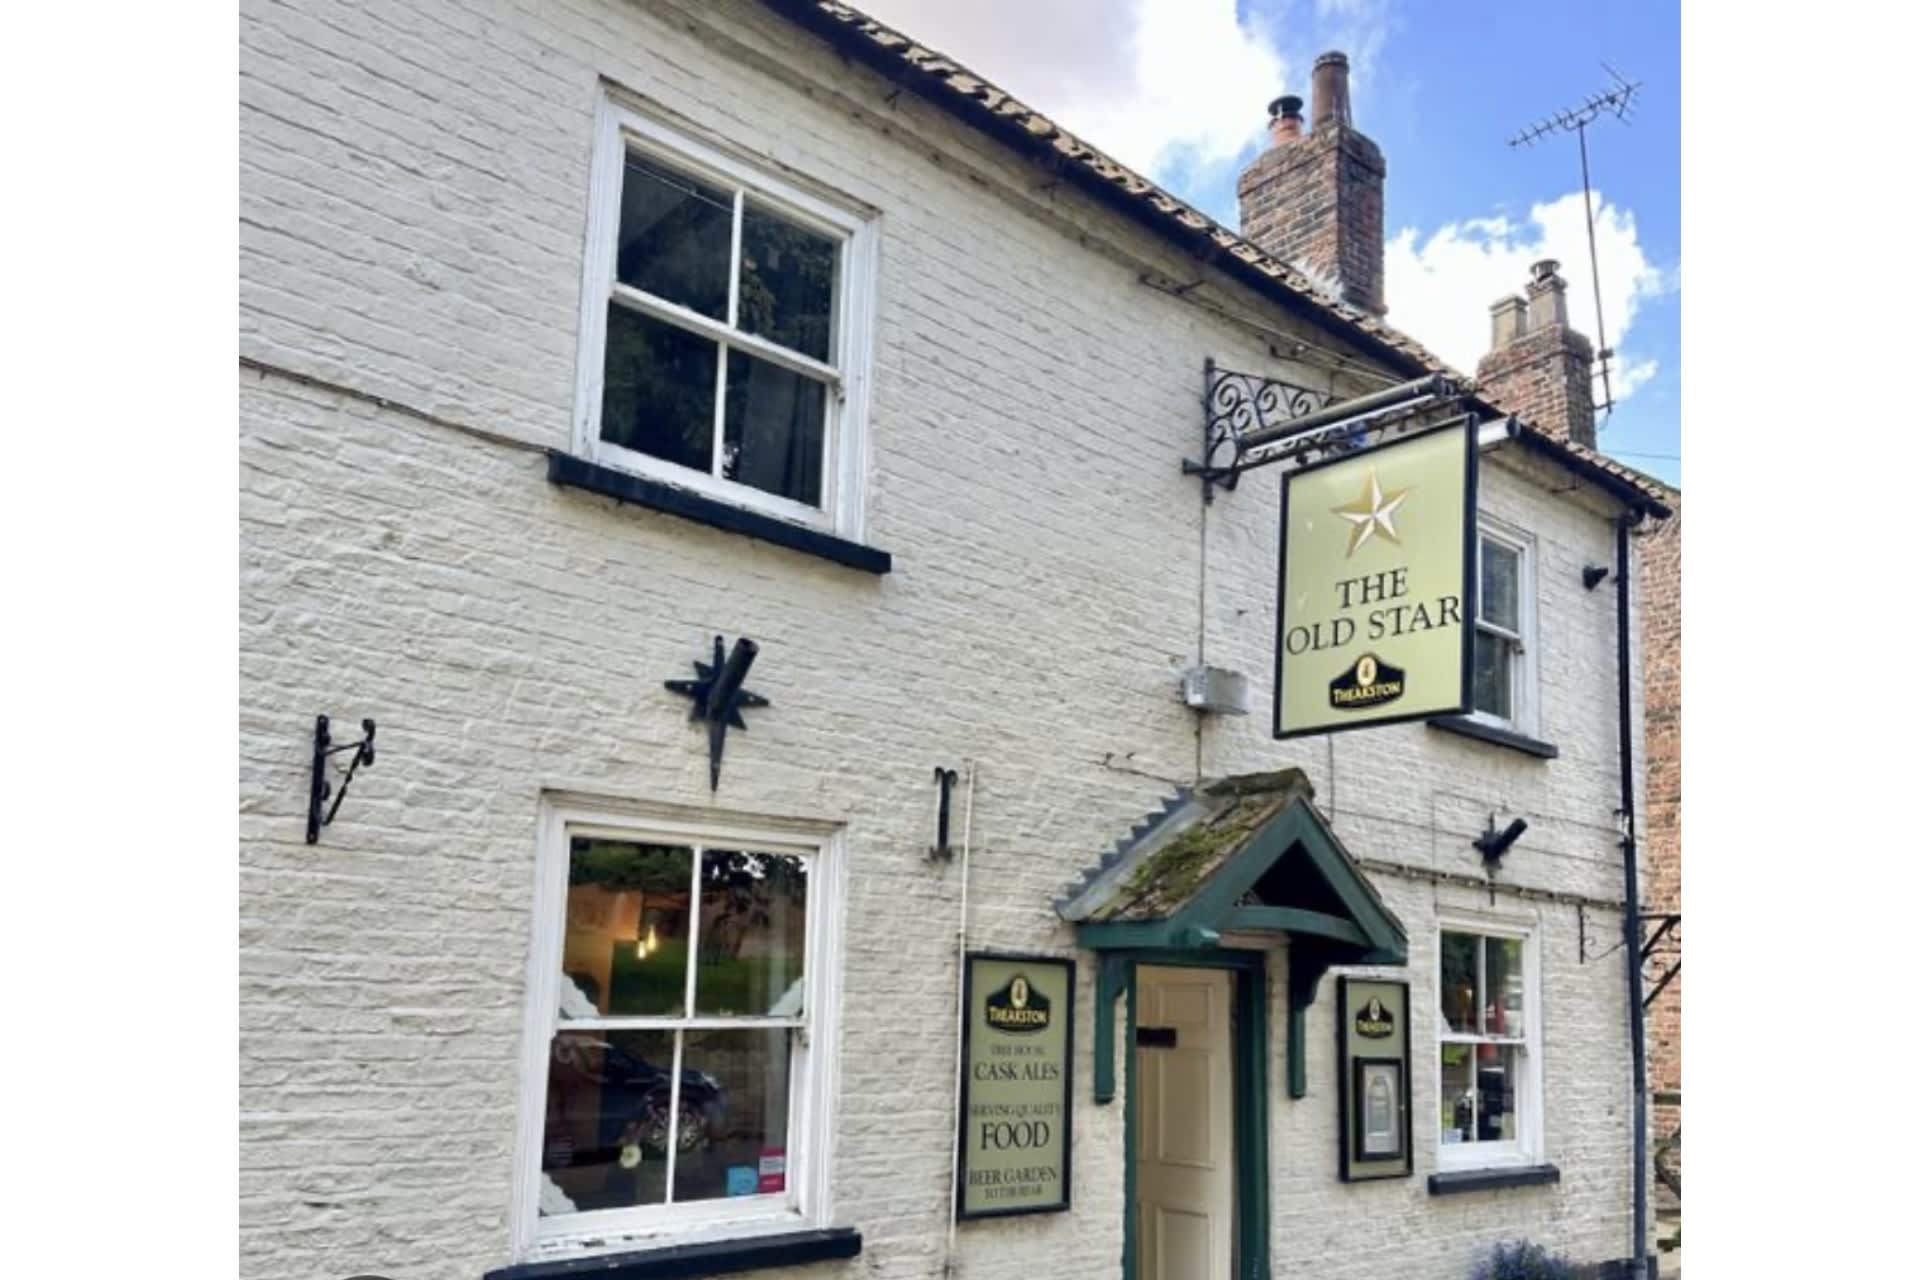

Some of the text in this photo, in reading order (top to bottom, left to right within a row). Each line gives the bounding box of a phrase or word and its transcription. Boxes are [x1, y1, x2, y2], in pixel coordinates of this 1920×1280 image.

[1335, 567, 1409, 609] THE
[1286, 596, 1462, 655] OLD STAR
[1333, 681, 1401, 703] THEAKSTON
[974, 1061, 1058, 1081] CASK ALES
[981, 1121, 1050, 1150] FOOD
[968, 1166, 1057, 1185] BEER GARDEN
